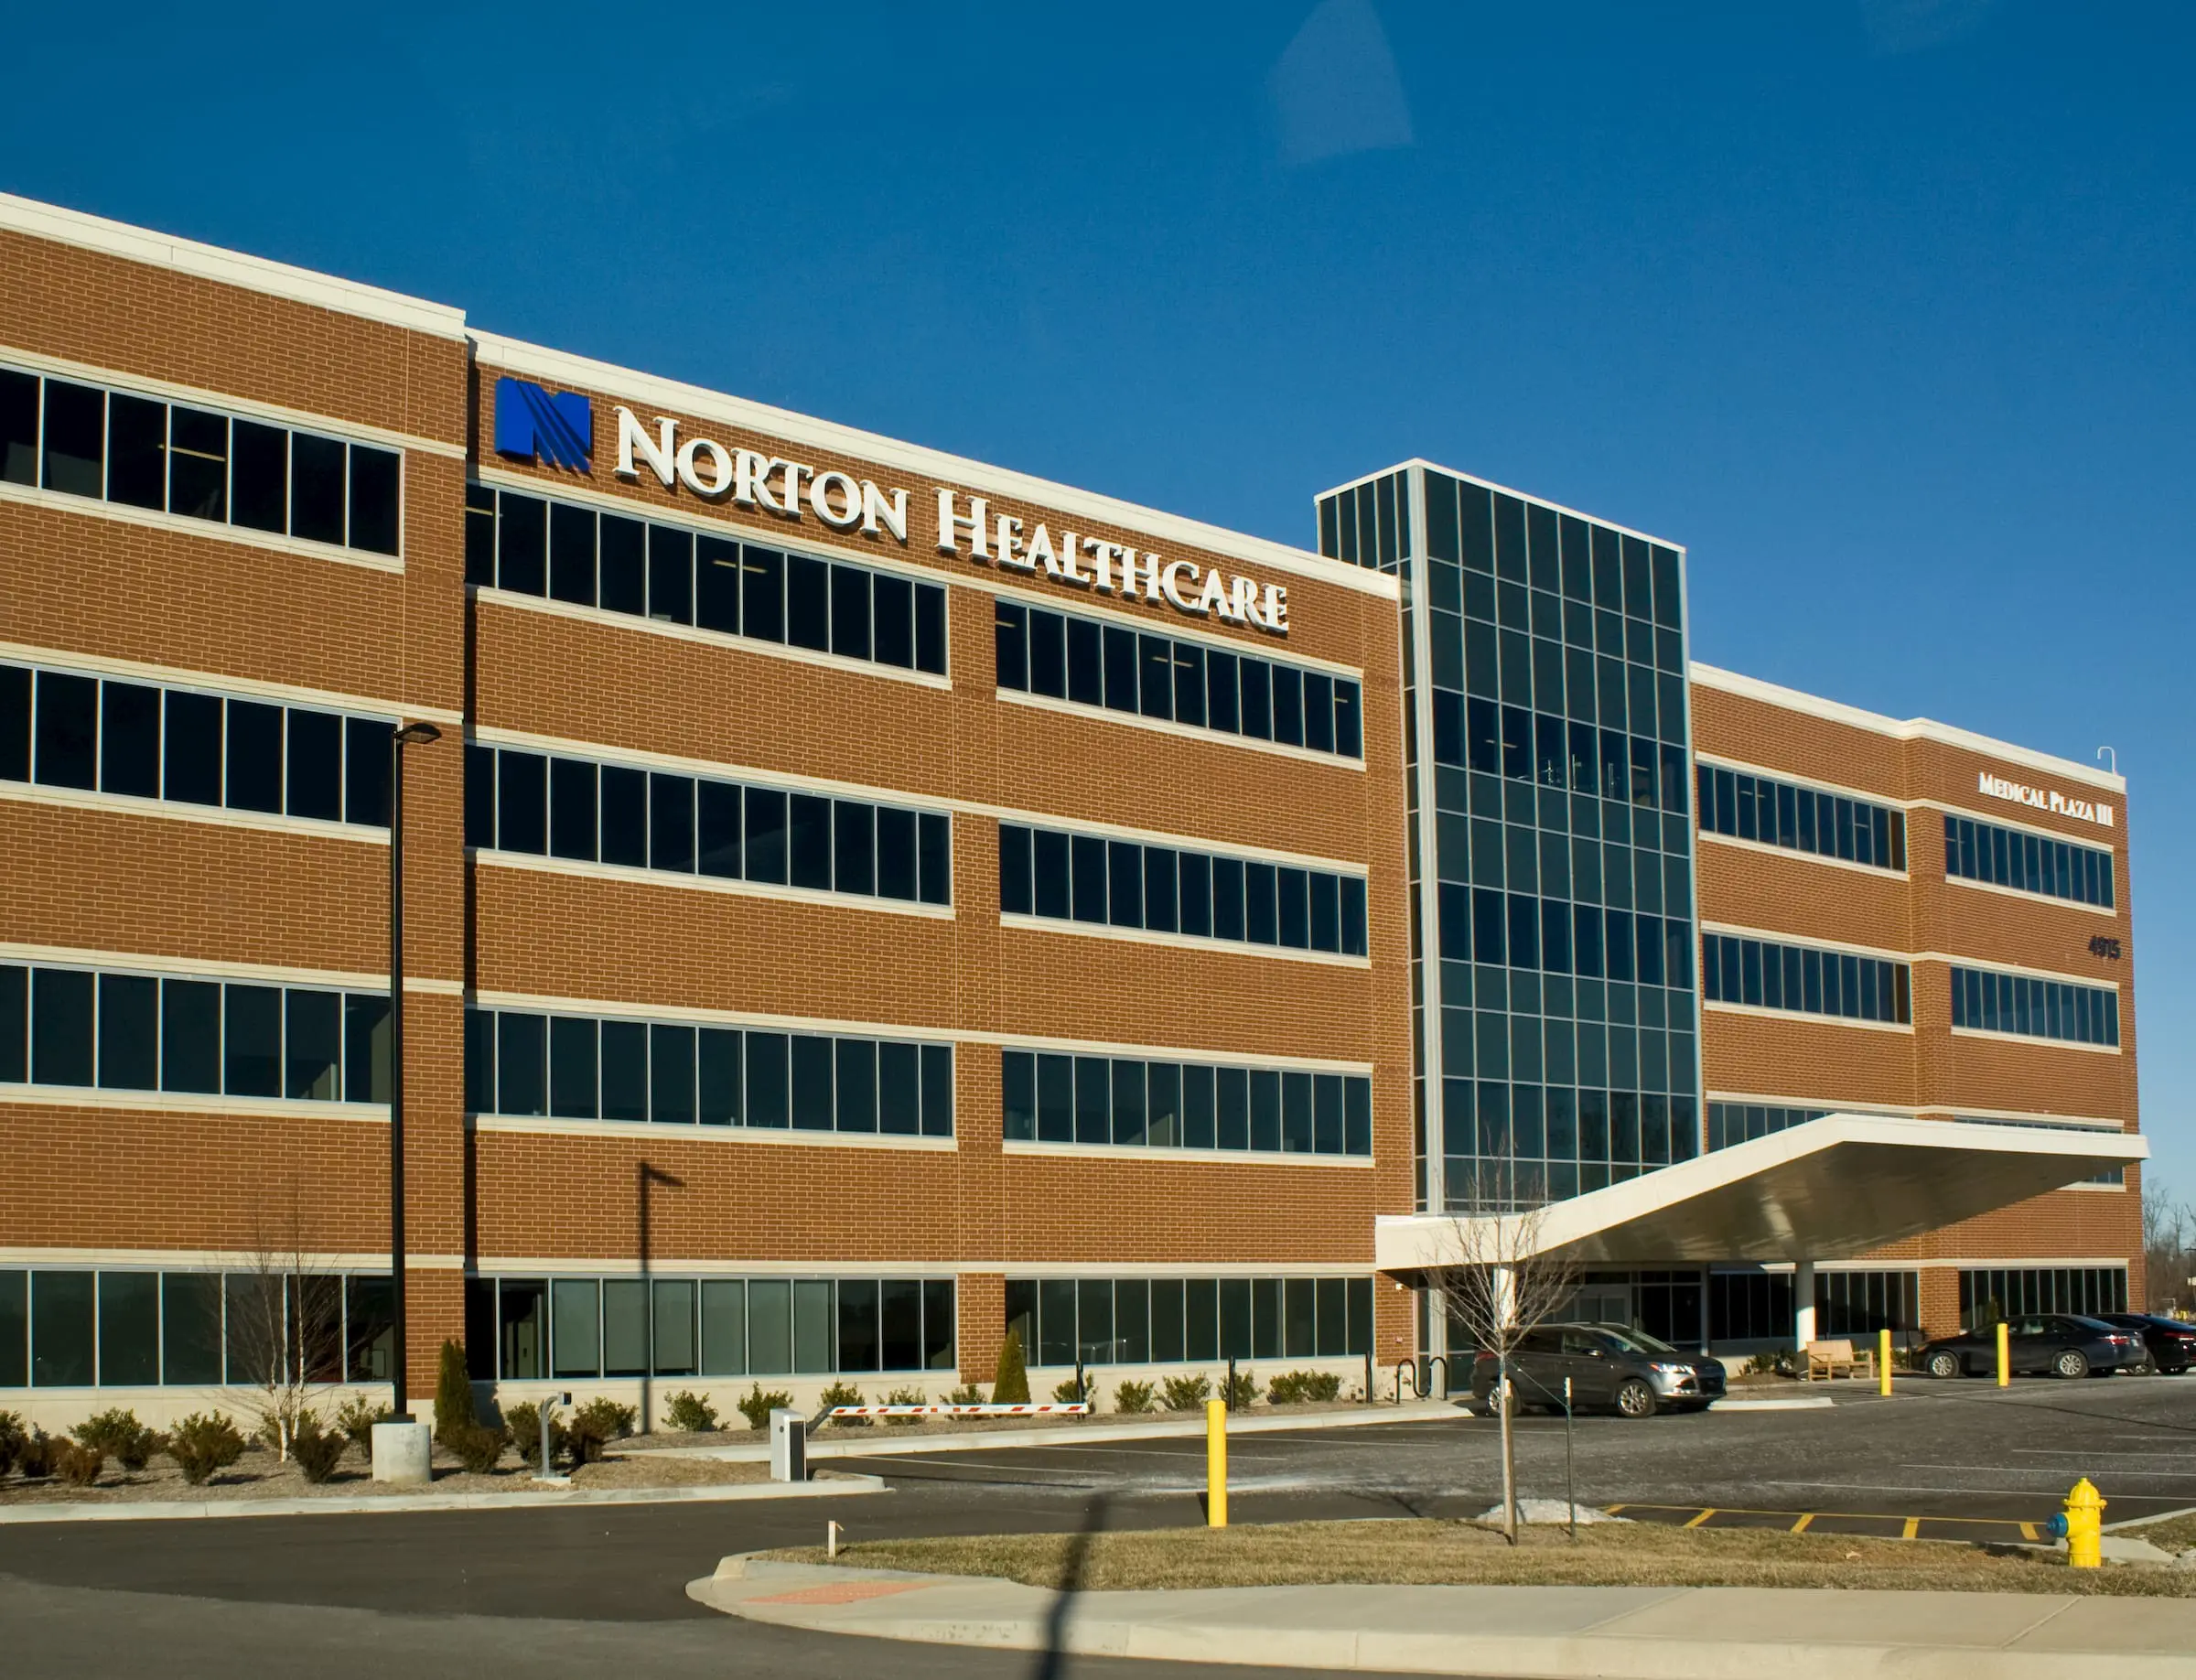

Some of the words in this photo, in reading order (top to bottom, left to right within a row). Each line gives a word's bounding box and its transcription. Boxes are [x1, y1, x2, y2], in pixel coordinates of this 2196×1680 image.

[612, 405, 911, 541] NORTON
[932, 487, 1290, 632] HEALTHCARE
[1978, 771, 2049, 809] MEDICAL
[2049, 791, 2095, 823] PLAZA
[2095, 803, 2115, 828] III
